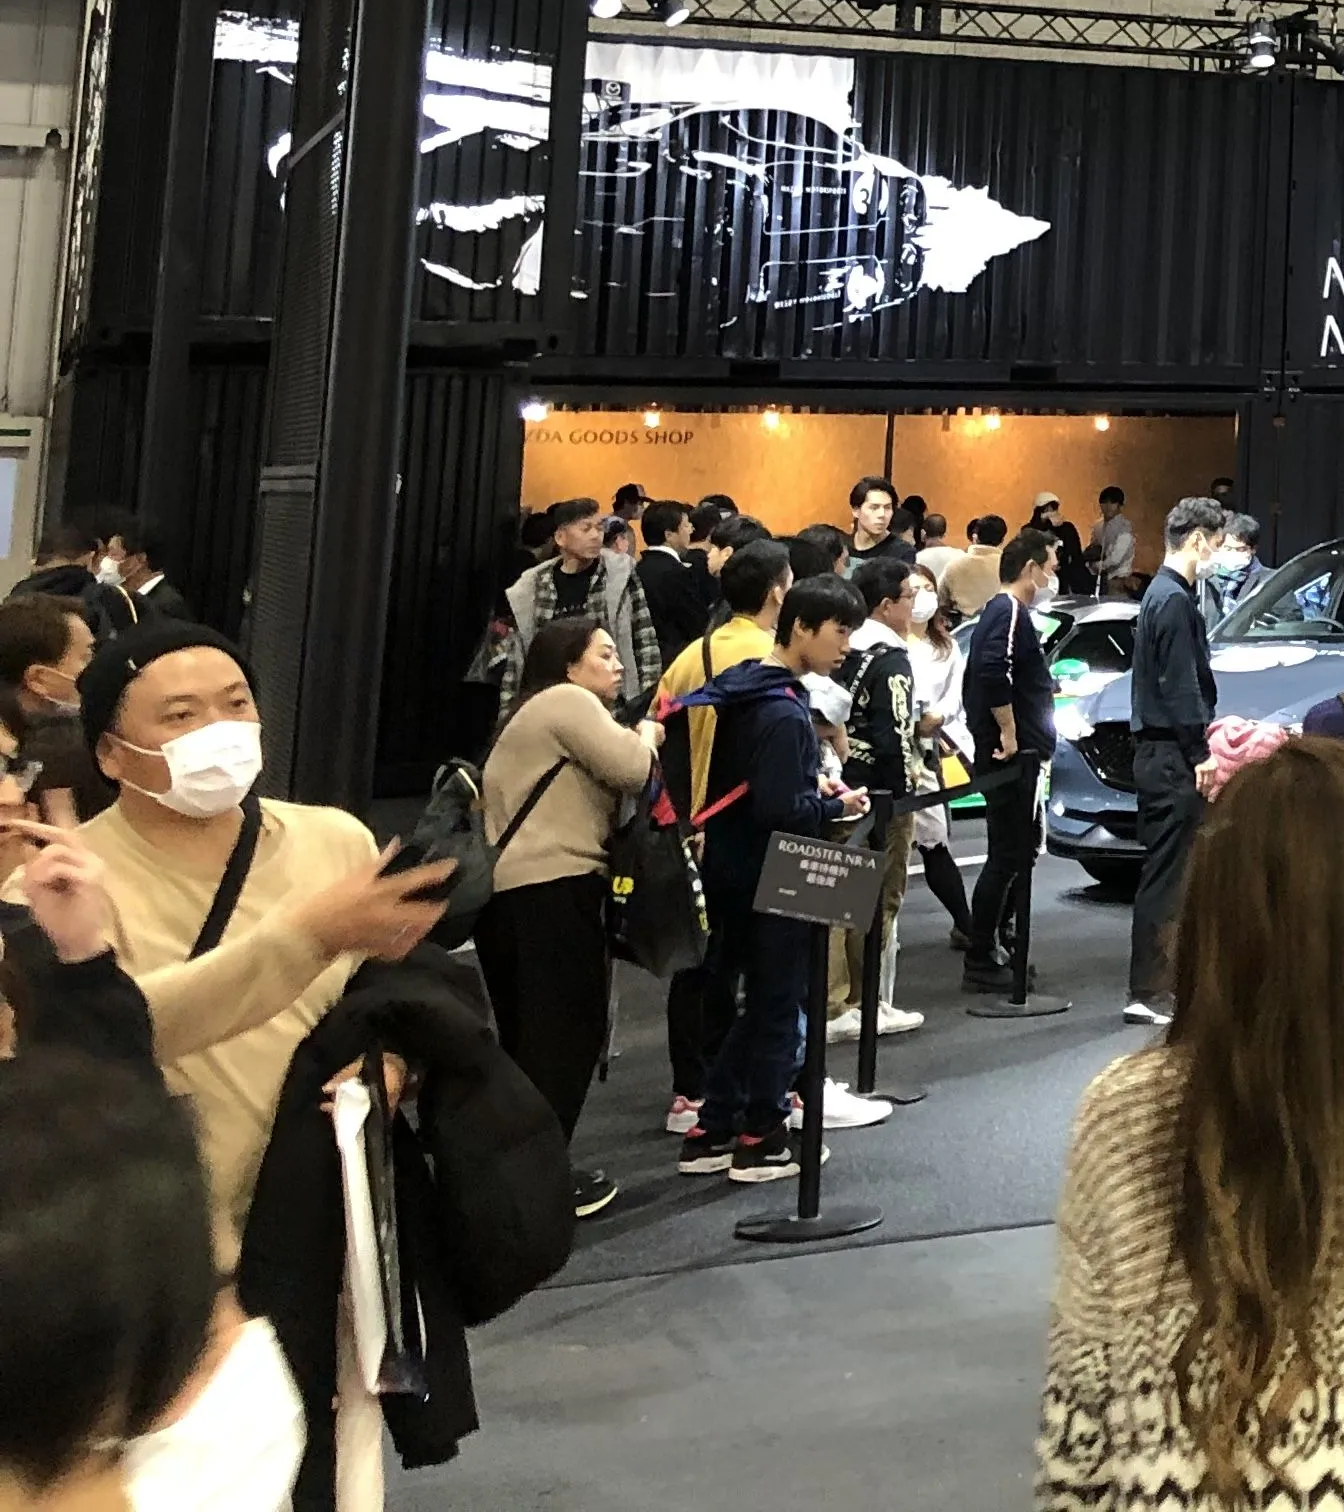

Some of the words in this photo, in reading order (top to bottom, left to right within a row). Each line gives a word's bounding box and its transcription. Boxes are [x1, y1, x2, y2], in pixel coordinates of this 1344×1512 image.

[569, 429, 639, 445] GOODS
[644, 429, 694, 445] SHOP
[778, 839, 843, 862] ROADSTER
